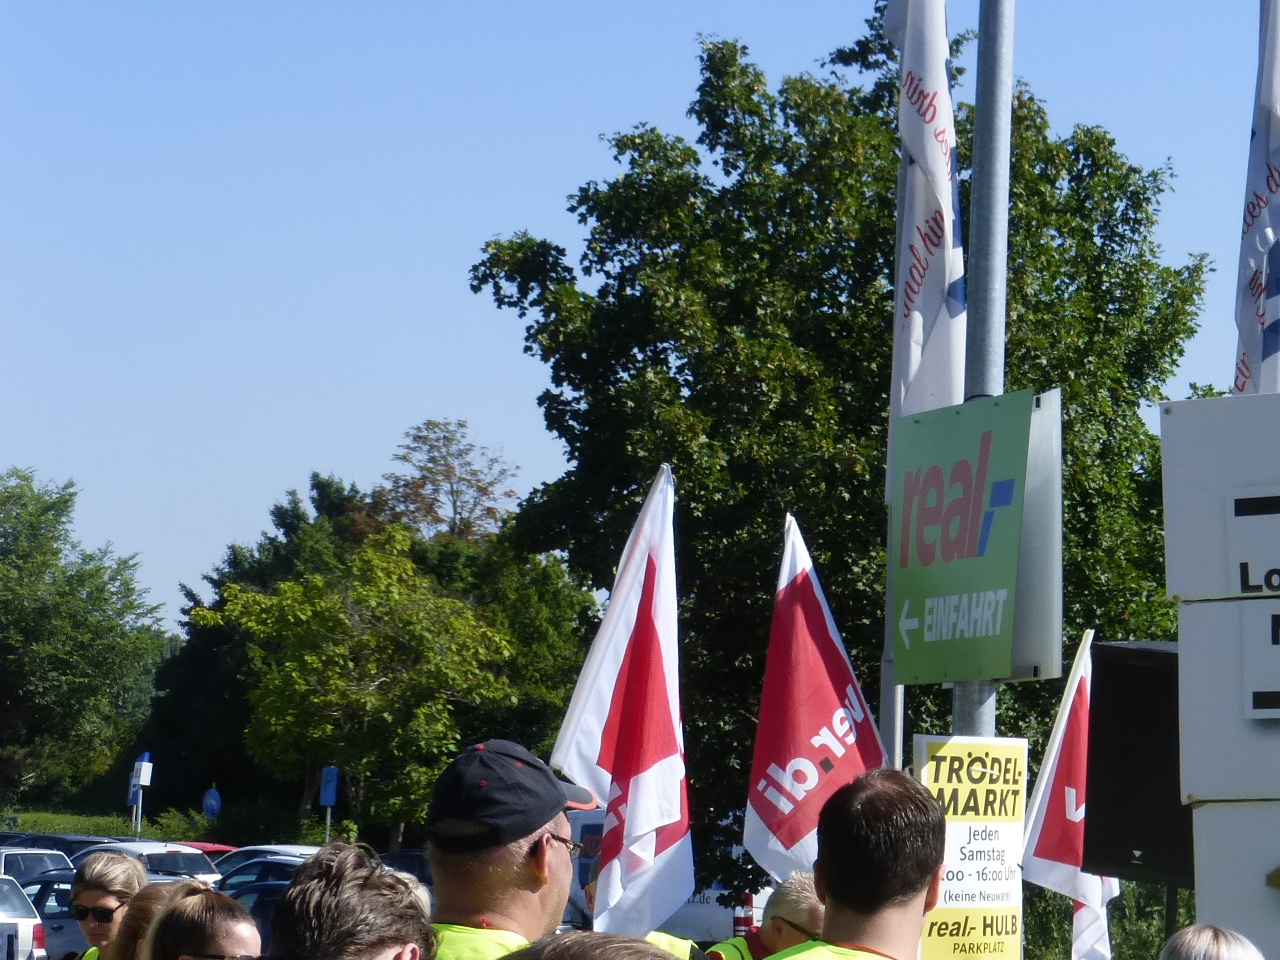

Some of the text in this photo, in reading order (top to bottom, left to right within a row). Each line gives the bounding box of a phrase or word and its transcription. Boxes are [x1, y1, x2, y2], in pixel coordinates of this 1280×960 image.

[924, 589, 1009, 643] EINFAHRT
[931, 751, 1022, 785] TRÖDEL-
[935, 787, 1020, 817] MARKT
[966, 825, 1000, 845] Jeden
[959, 846, 1005, 866] Samstag
[976, 867, 1003, 882] 16:00
[1004, 866, 1016, 881] Uhr
[943, 889, 1012, 904] (keine Neuware)
[982, 915, 1018, 937] HULB
[952, 941, 1005, 955] PARKPLATZ
